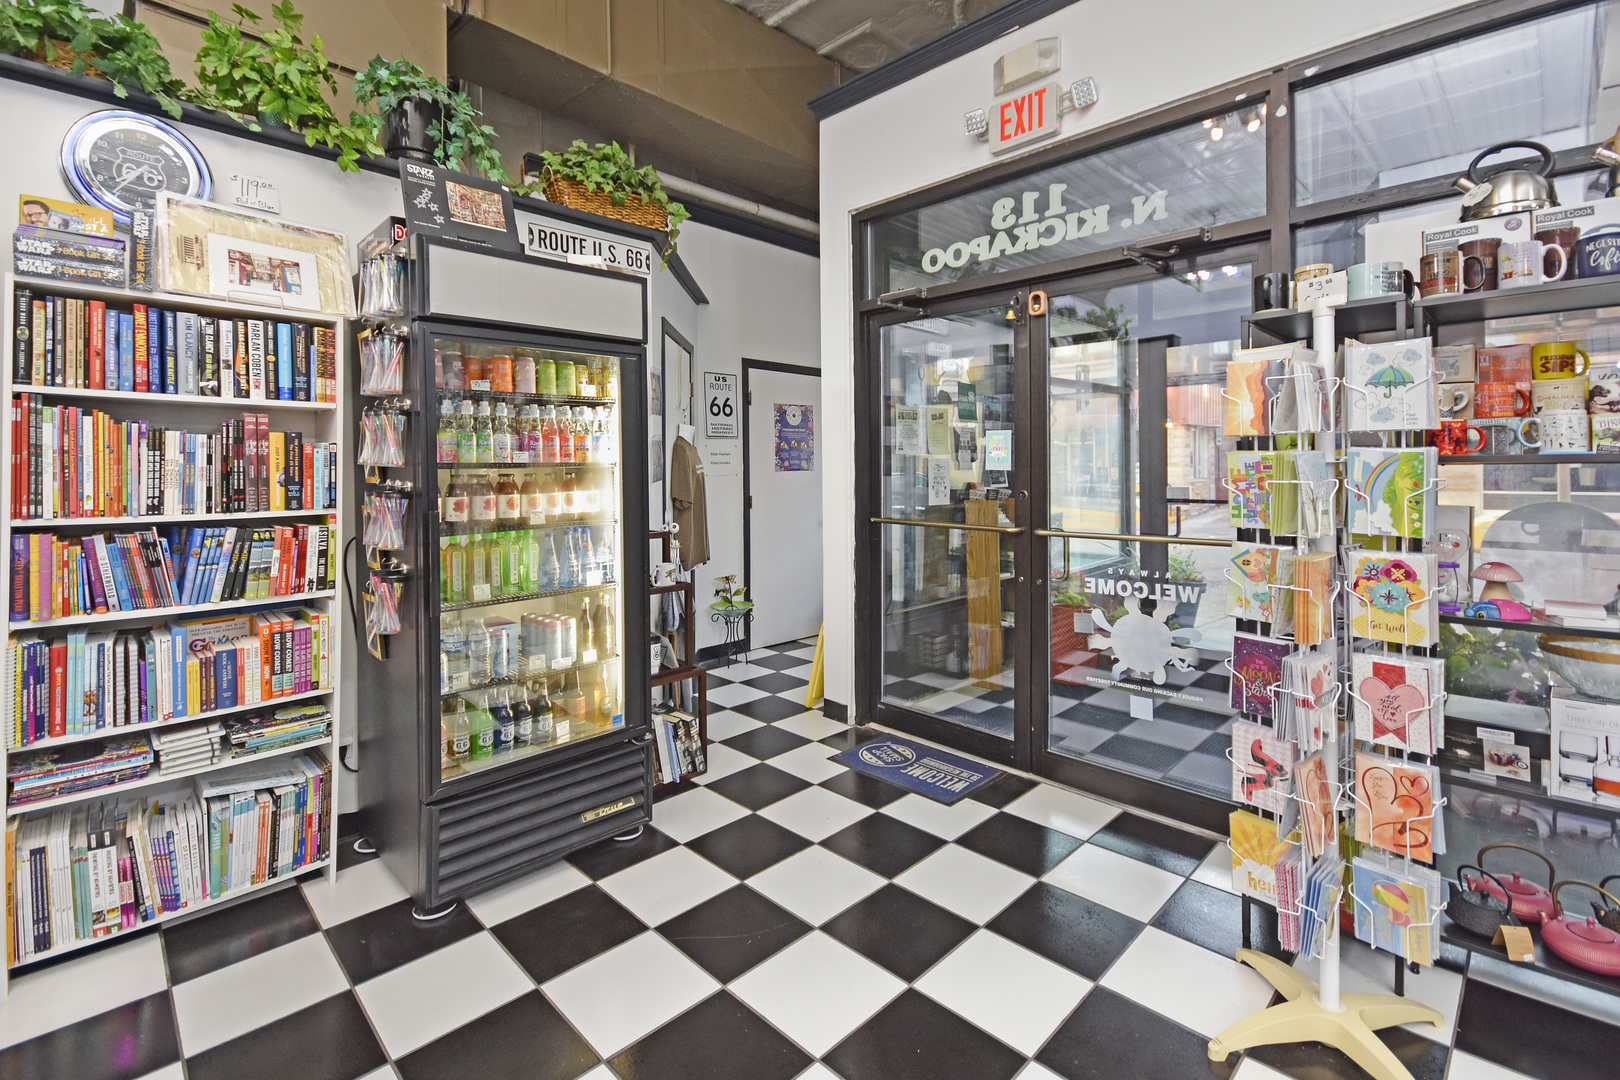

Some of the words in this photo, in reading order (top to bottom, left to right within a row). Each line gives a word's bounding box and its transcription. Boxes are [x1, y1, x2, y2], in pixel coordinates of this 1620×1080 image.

[1000, 87, 1047, 142] EXIT
[126, 151, 156, 163] ROUTE
[406, 164, 435, 177] STARZ
[1537, 213, 1565, 223] Royal
[1566, 208, 1593, 218] Cook
[1427, 232, 1452, 241] Royal
[1454, 227, 1477, 237] Cook
[17, 244, 56, 255] WARS
[86, 251, 101, 259] Gift
[18, 239, 52, 248] STAR
[538, 228, 587, 255] ROUTE
[626, 249, 643, 269] 66
[17, 264, 56, 275] WARS
[18, 259, 53, 268] STAR
[135, 311, 147, 328] JANET
[185, 317, 193, 331] TOM
[206, 324, 214, 335] TOM
[250, 323, 260, 352] HARLAN
[135, 330, 147, 361] EVANOVICH
[185, 333, 194, 360] CLANCY
[206, 335, 214, 354] CLANCY
[224, 342, 232, 358] Clancy
[252, 354, 262, 377] COBEN
[317, 349, 326, 378] JOHNSON
[326, 352, 335, 379] JOHNSON
[1540, 360, 1576, 374] SIPS
[709, 383, 732, 392] ROUTE
[710, 396, 734, 418] 66
[319, 532, 328, 550] SILVA
[14, 561, 24, 570] KEY
[15, 575, 24, 599] SKELETON
[101, 562, 116, 599] OTHERWORLD
[15, 600, 24, 612] PEAK
[264, 657, 268, 665] ME
[1244, 681, 1276, 701] Stars
[456, 741, 468, 749] 66
[872, 749, 894, 763] SHOP
[880, 746, 904, 762] SMALL
[900, 763, 970, 793] WELCOME
[213, 833, 221, 850] PAPER
